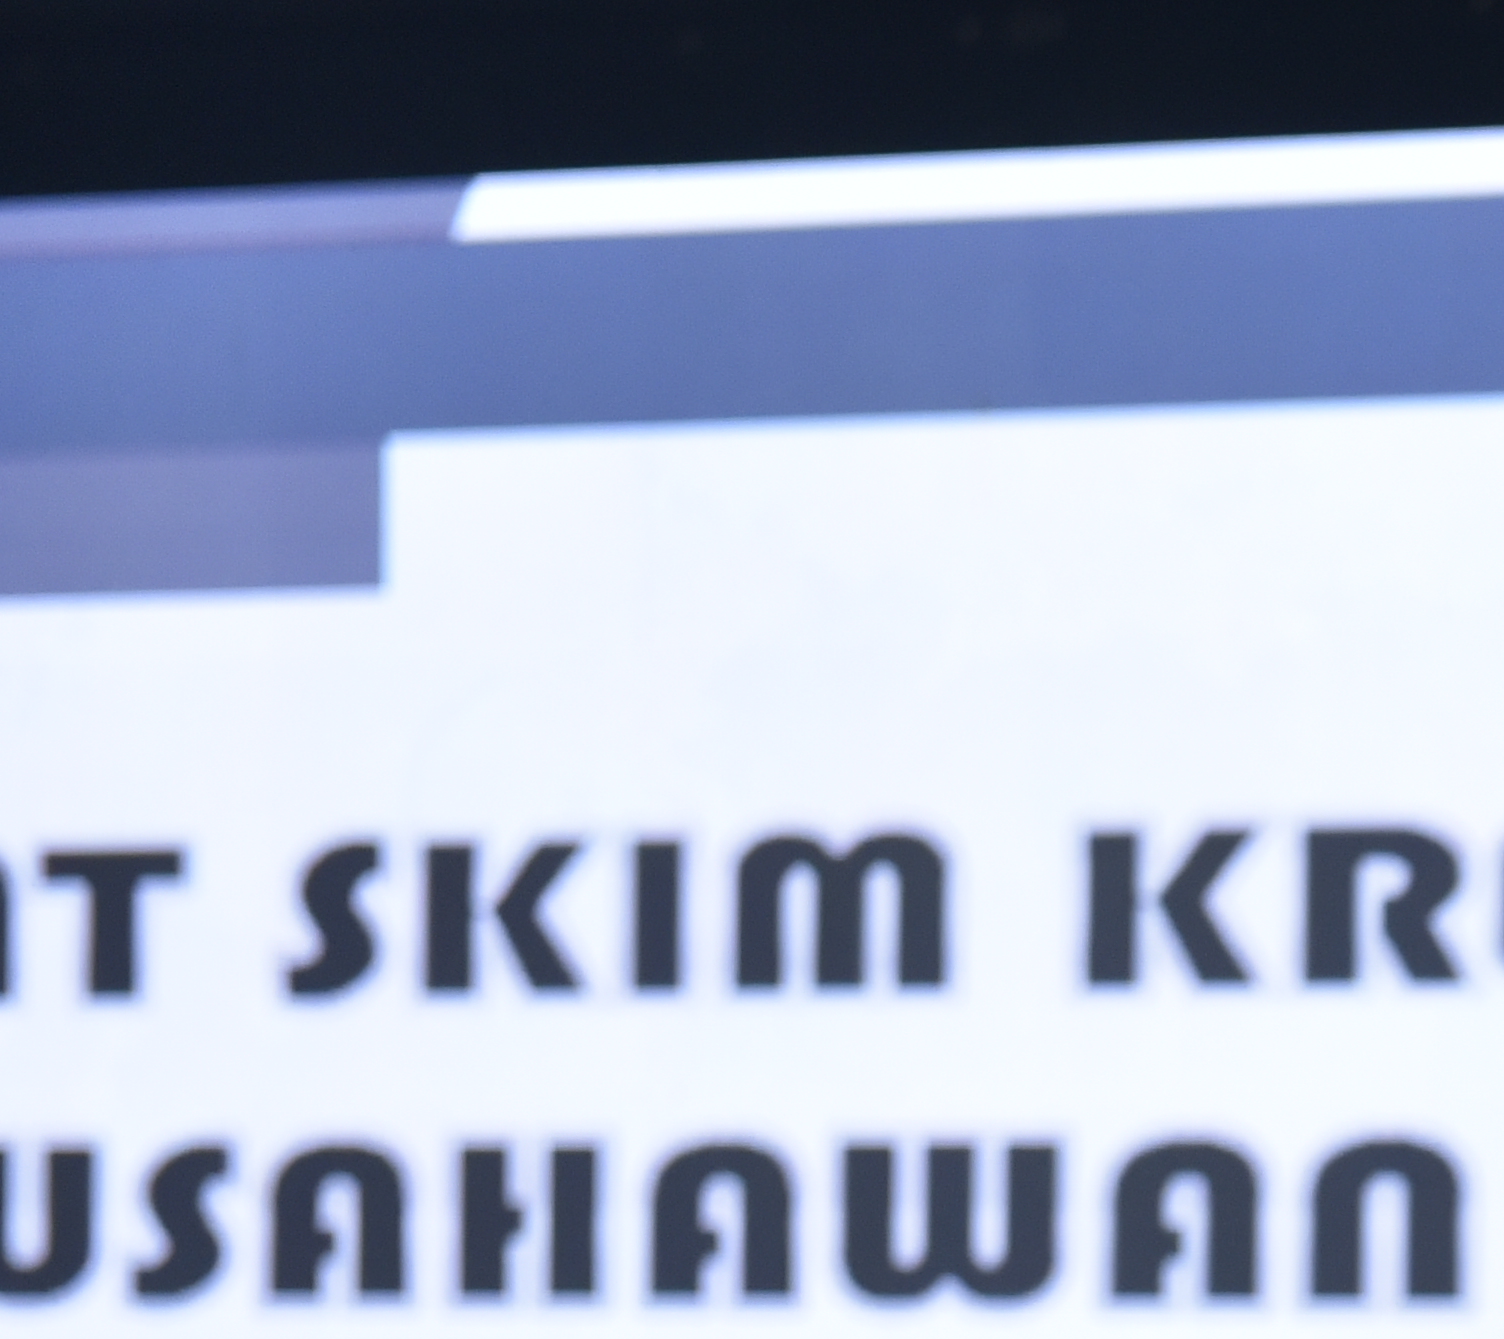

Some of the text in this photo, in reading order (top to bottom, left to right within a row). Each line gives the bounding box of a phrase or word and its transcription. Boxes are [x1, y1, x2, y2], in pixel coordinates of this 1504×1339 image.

[0, 850, 183, 998] T
[287, 833, 946, 998] SKIM
[0, 1140, 1461, 1301] USAHAWAN
